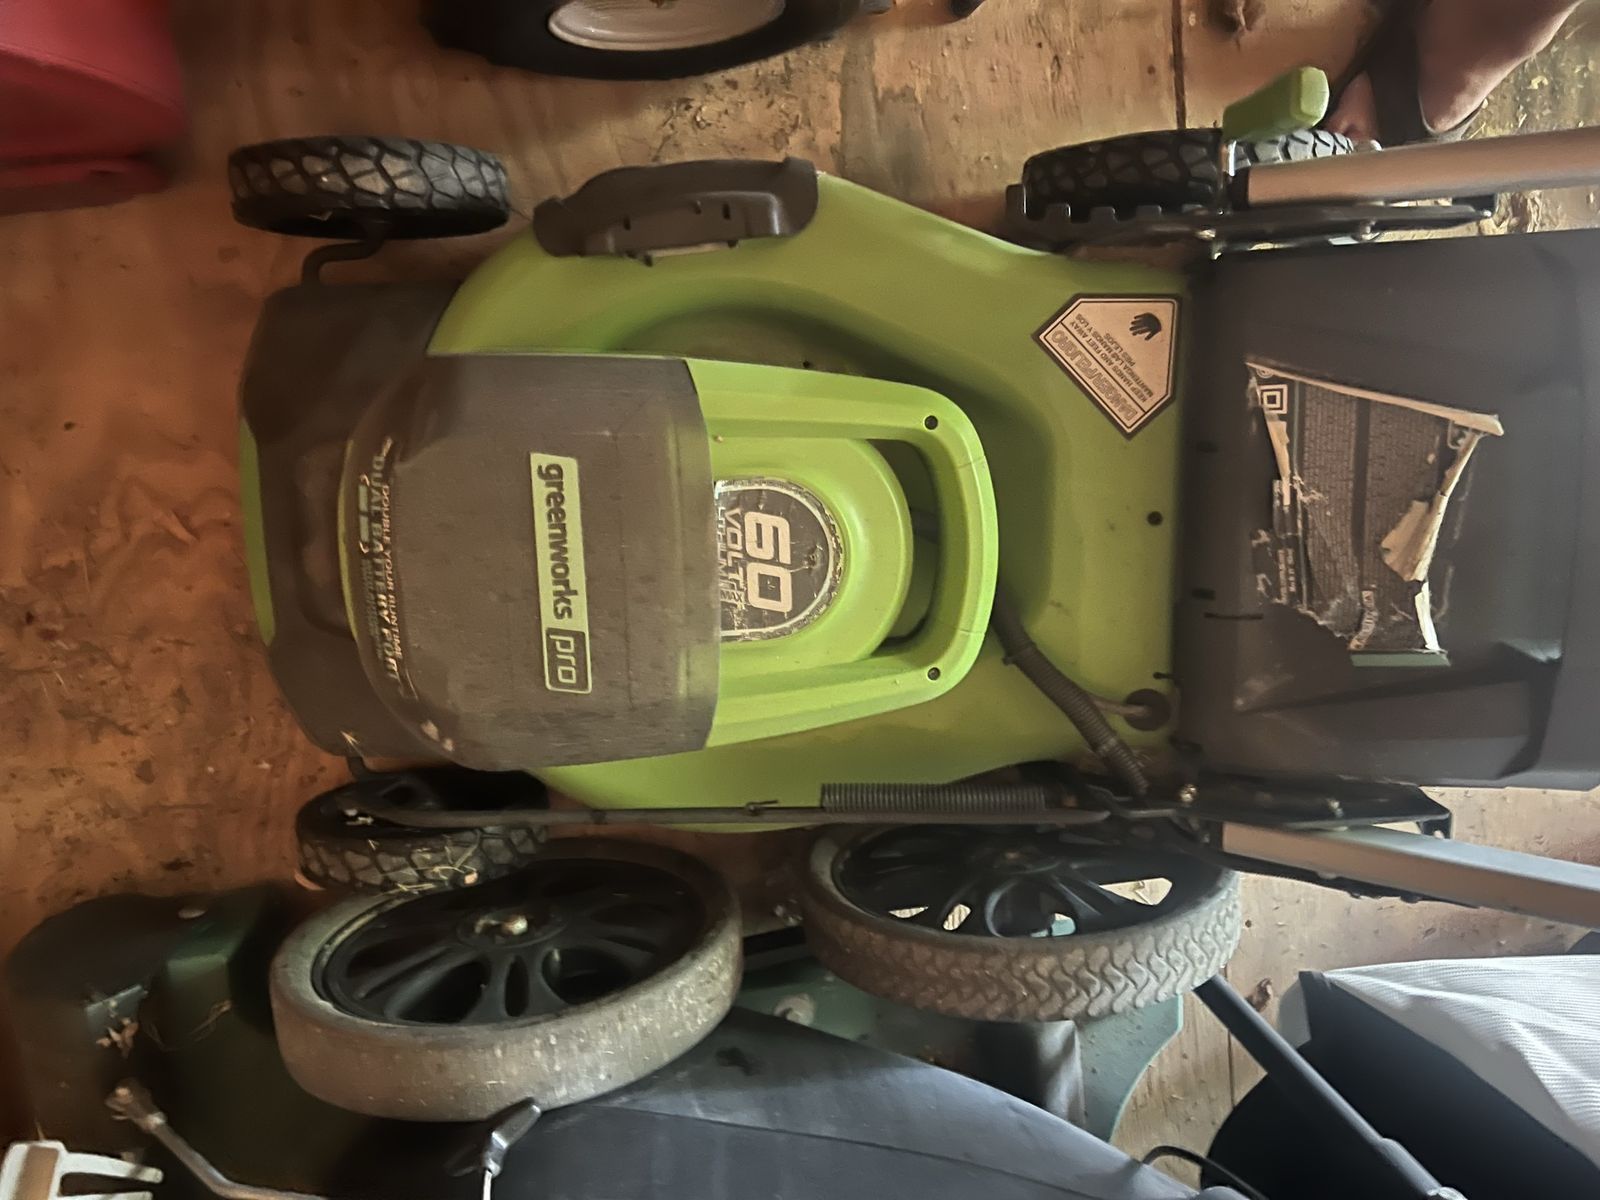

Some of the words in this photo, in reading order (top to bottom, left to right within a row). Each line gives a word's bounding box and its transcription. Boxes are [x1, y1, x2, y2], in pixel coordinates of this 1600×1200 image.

[1069, 319, 1089, 339] AWAY
[1074, 313, 1089, 327] LOS
[1085, 336, 1102, 354] FEET
[1091, 330, 1114, 354] MANOS
[1099, 351, 1114, 367] AND
[1103, 332, 1123, 353] LEJOS
[1110, 351, 1124, 365] LAS
[1119, 351, 1135, 367] PIES
[1111, 364, 1133, 387] HANDS
[1122, 363, 1154, 397] MANTENGA
[1130, 385, 1147, 403] KEEP
[371, 454, 385, 517] DUAL
[382, 484, 391, 545] DOUBLE
[537, 463, 578, 620] greenworks
[725, 507, 745, 588] VOLT
[372, 522, 391, 623] BATTERY
[383, 550, 395, 591] YOUR
[744, 511, 793, 613] 60
[388, 594, 403, 660] RUNTIME
[380, 627, 401, 683] PORT
[549, 635, 577, 684] pro
